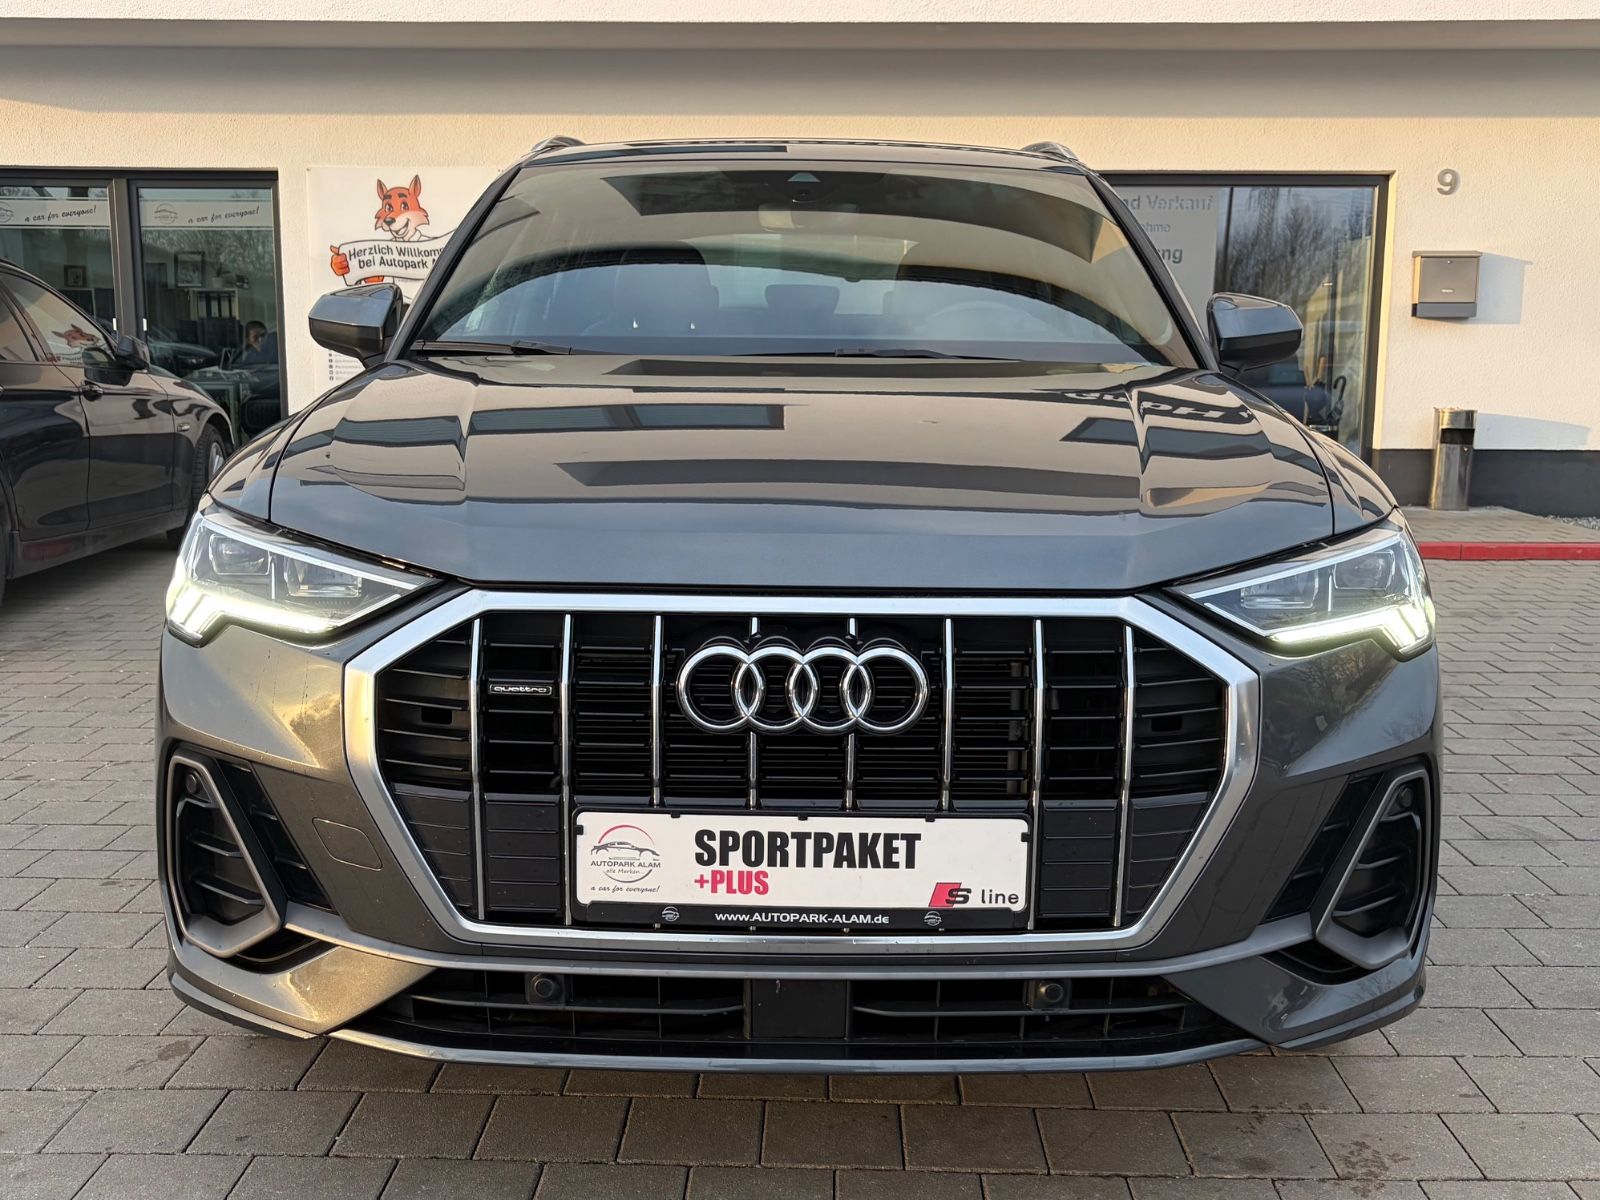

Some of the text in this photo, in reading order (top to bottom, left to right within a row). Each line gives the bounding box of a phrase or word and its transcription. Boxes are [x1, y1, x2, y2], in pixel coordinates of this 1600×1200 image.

[1437, 168, 1459, 195] 9
[48, 211, 59, 221] for
[62, 204, 97, 217] everyone!
[348, 244, 443, 261] Herzlich Willkom
[358, 255, 376, 270] bei
[379, 256, 429, 271] Autopark
[694, 829, 922, 870] SPORTPAKET
[590, 860, 636, 868] AUTOPARK
[611, 885, 624, 894] for
[625, 885, 661, 894] everyone!
[694, 869, 770, 896] +PLUS
[981, 889, 1019, 905] line
[715, 912, 890, 925] www.AUTOPARK-ALAM.de
